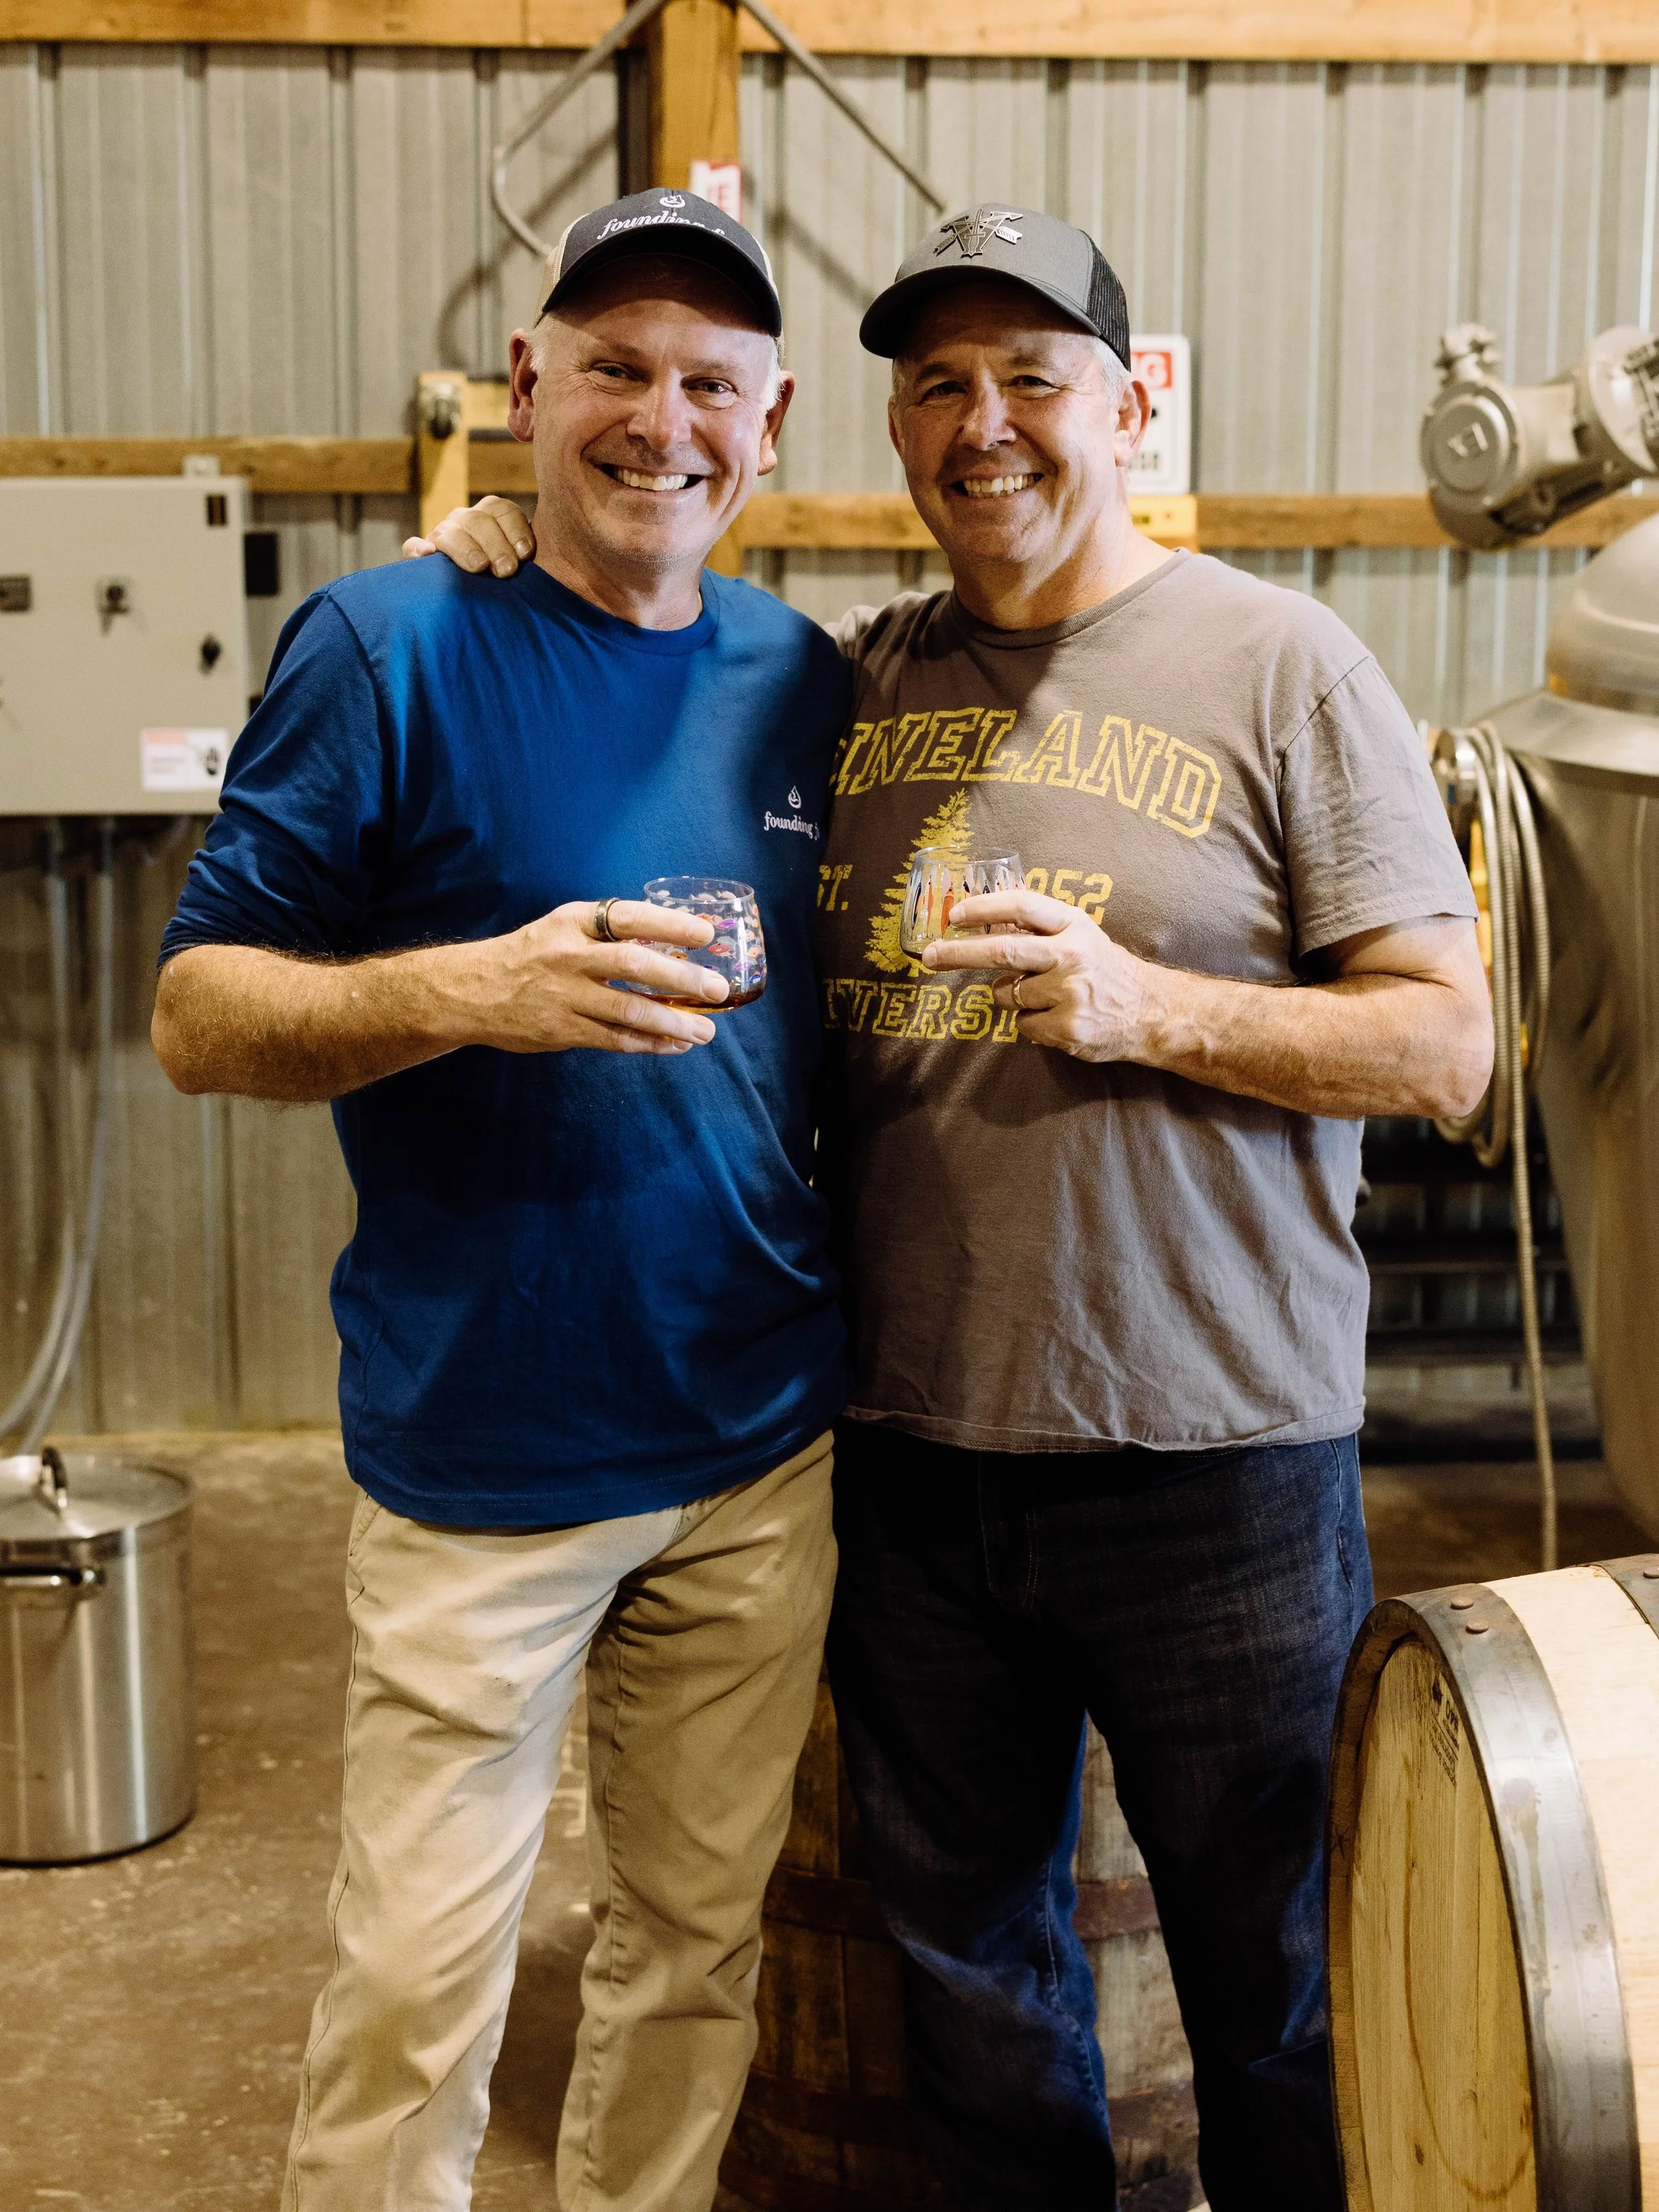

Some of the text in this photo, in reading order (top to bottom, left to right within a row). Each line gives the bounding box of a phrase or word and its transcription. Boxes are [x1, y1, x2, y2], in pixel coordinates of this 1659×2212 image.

[829, 706, 1222, 838] INELAND
[763, 811, 813, 839] founding
[1022, 867, 1114, 925] 952
[822, 978, 1035, 1044] IVERSI
